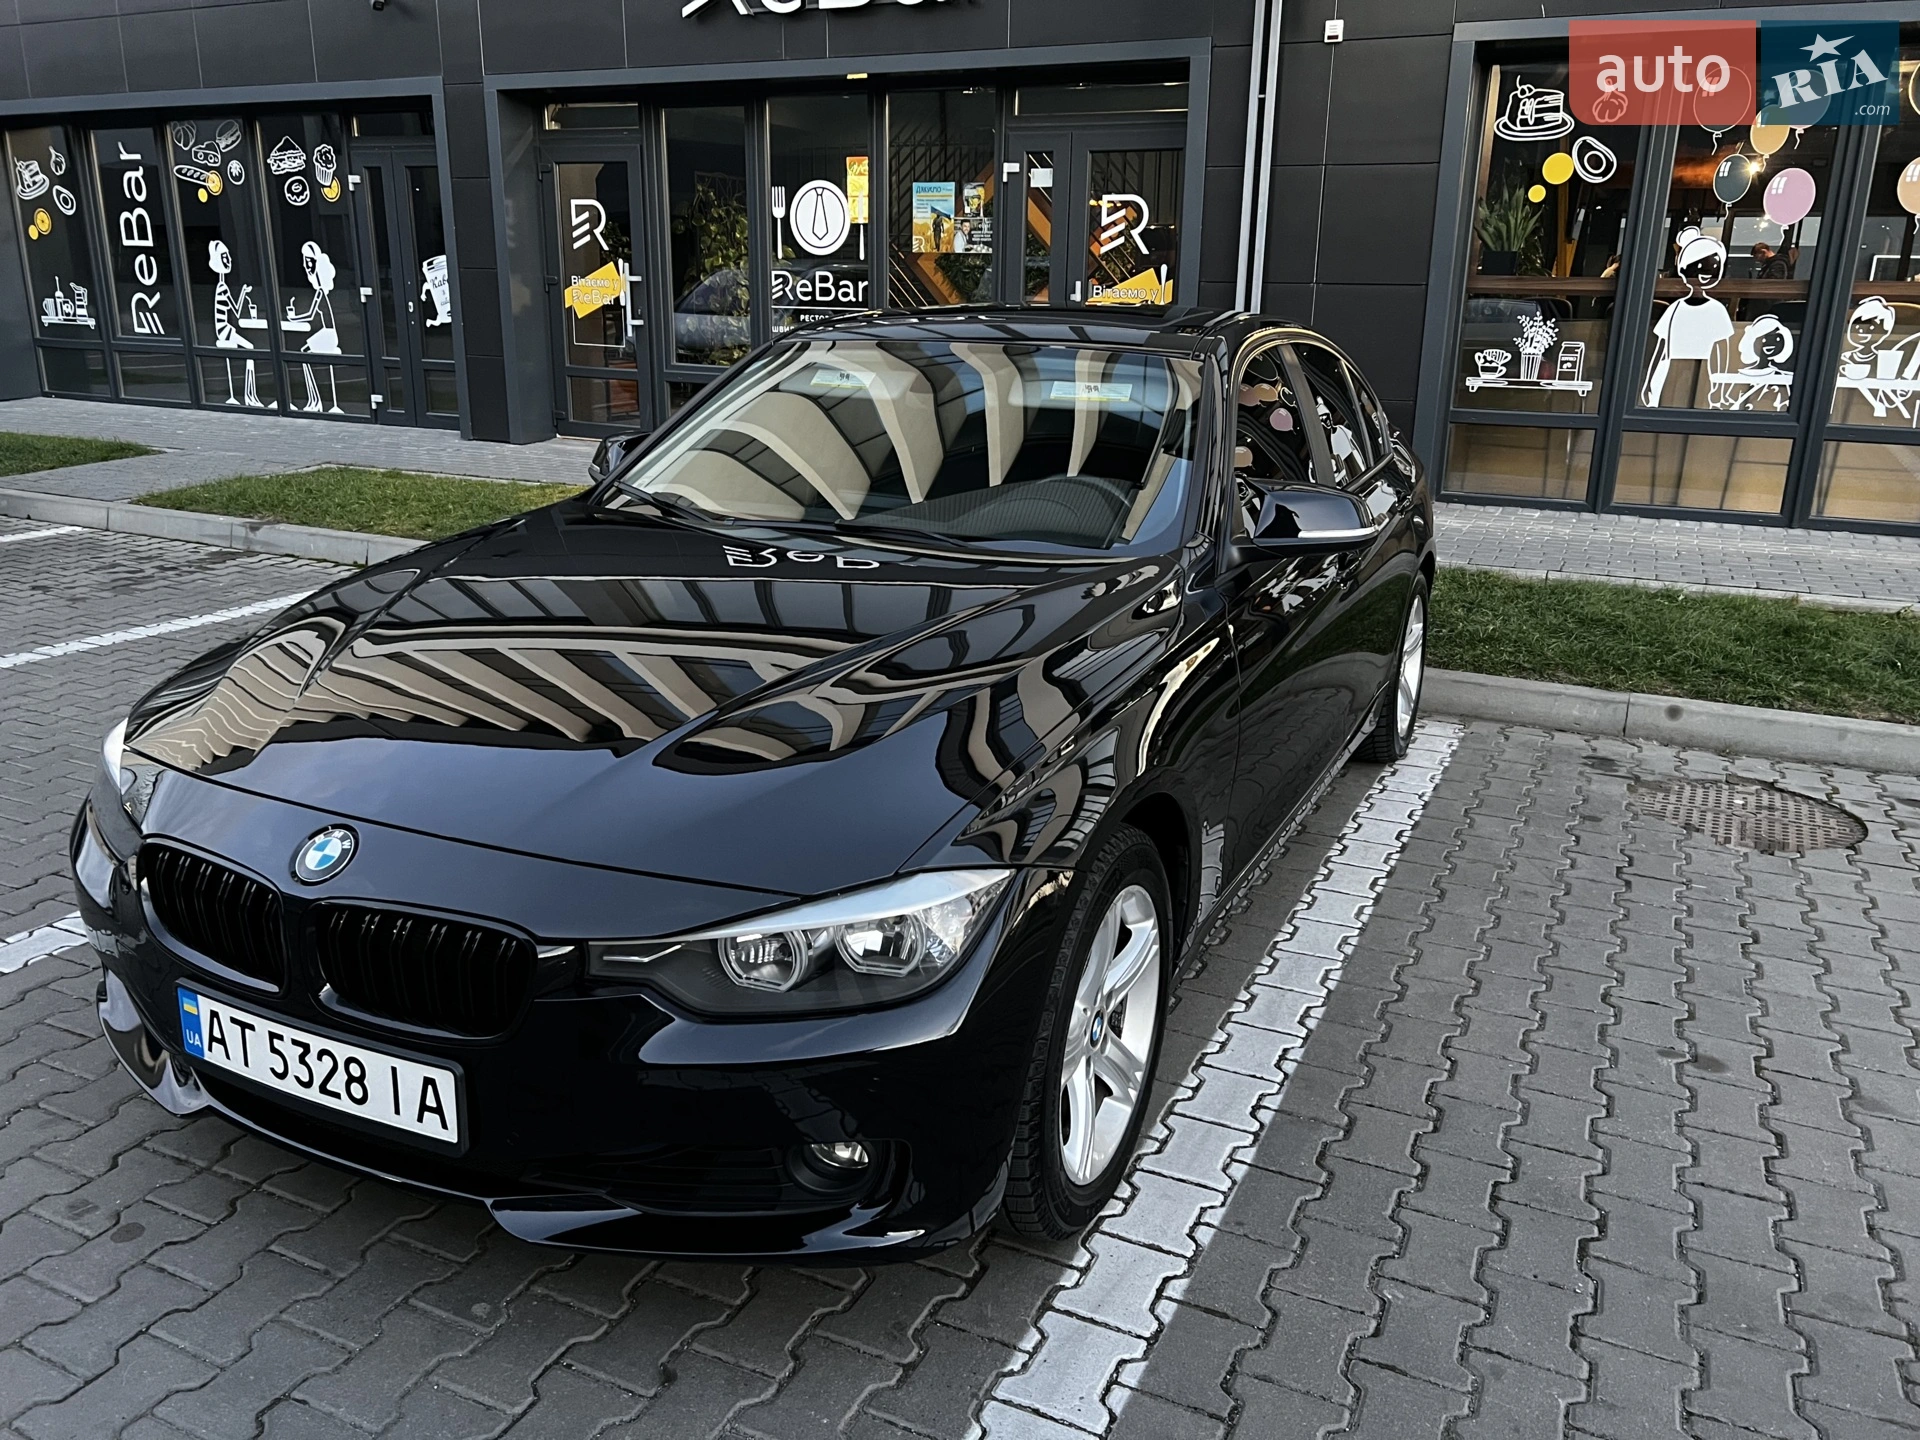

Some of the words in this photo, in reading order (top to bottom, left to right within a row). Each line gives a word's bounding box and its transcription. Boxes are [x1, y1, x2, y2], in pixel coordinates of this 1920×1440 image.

[117, 141, 165, 335] ReBar
[571, 275, 611, 288] Вітаємо
[771, 270, 869, 302] ReBar
[572, 288, 614, 305] ReBar
[1093, 285, 1147, 299] Вітаємо
[1150, 288, 1159, 302] у
[800, 314, 829, 322] РЕСТО
[772, 325, 794, 333] ШВИ
[314, 830, 352, 849] BMW
[186, 1029, 202, 1048] UA
[208, 1009, 256, 1068] AT
[267, 1030, 369, 1105] 5328
[390, 1065, 449, 1131] IA
